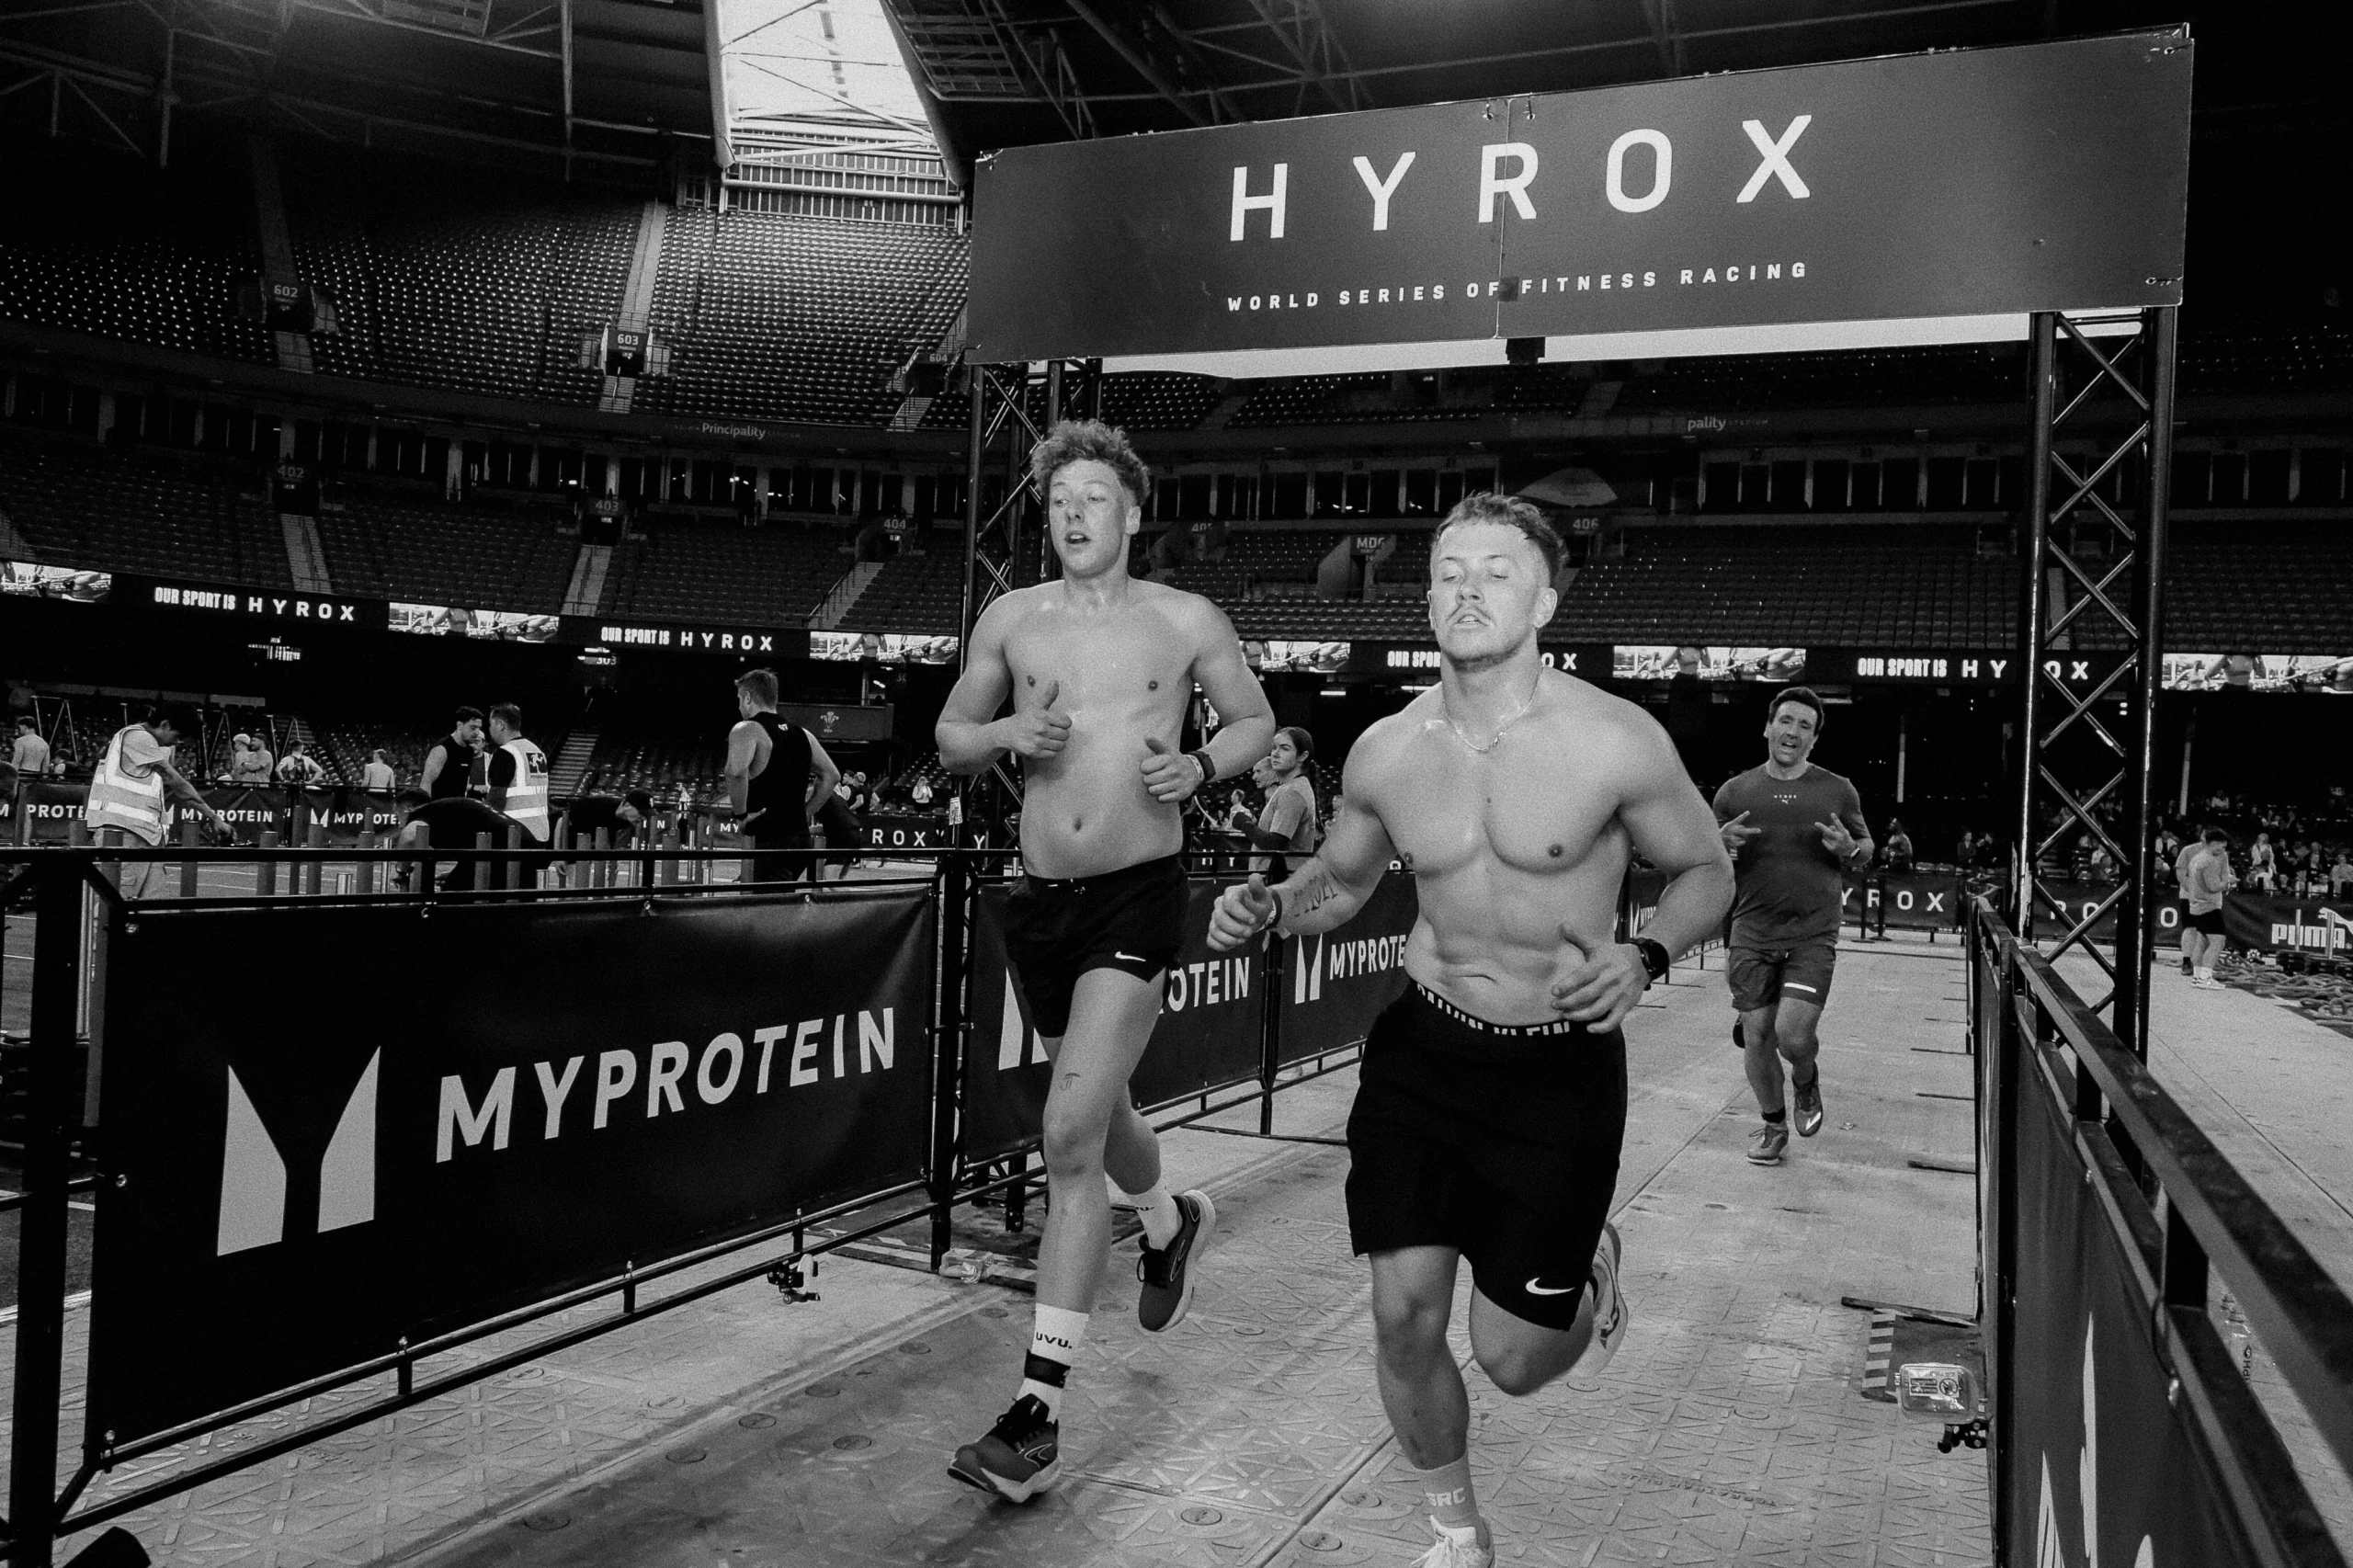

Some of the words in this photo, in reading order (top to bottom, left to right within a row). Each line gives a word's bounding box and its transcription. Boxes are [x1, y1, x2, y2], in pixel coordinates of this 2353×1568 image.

[1230, 115, 1812, 242] HYROX
[274, 284, 298, 298] 602
[1227, 292, 1319, 312] WORLD
[1338, 284, 1445, 306] SERIES
[1466, 280, 1499, 298] OF
[1521, 271, 1656, 295] FITNESS
[1680, 261, 1805, 285] RACING
[617, 334, 639, 346] 603
[929, 353, 948, 362] 604
[702, 422, 766, 439] Principality
[1688, 416, 1726, 431] pality
[278, 465, 304, 478] 402
[596, 499, 619, 512] 403
[883, 518, 906, 529] 404
[154, 586, 179, 604] OUR
[183, 589, 221, 608] SPORT
[223, 594, 235, 610] IS
[248, 596, 355, 621] HYROX
[601, 627, 622, 642] OUR
[624, 629, 657, 644] SPORT
[659, 631, 670, 645] IS
[680, 631, 772, 651] HYROX
[1388, 651, 1409, 667] OUR
[1412, 651, 1440, 667] SPOR
[1858, 658, 1884, 676] OUR
[1888, 658, 1930, 677] SPORT
[1933, 659, 1947, 677] IS
[1961, 659, 2088, 680] HYOX
[181, 808, 273, 823] MYROTEIN
[334, 812, 401, 824] MYPOTE
[872, 829, 926, 846] ROX
[1841, 888, 1944, 912] YROX
[2271, 923, 2346, 949] PUMA
[1330, 935, 1406, 980] MYPROTE
[1168, 957, 1249, 1011] OTEIN
[437, 1007, 894, 1164] MYPROTEIN
